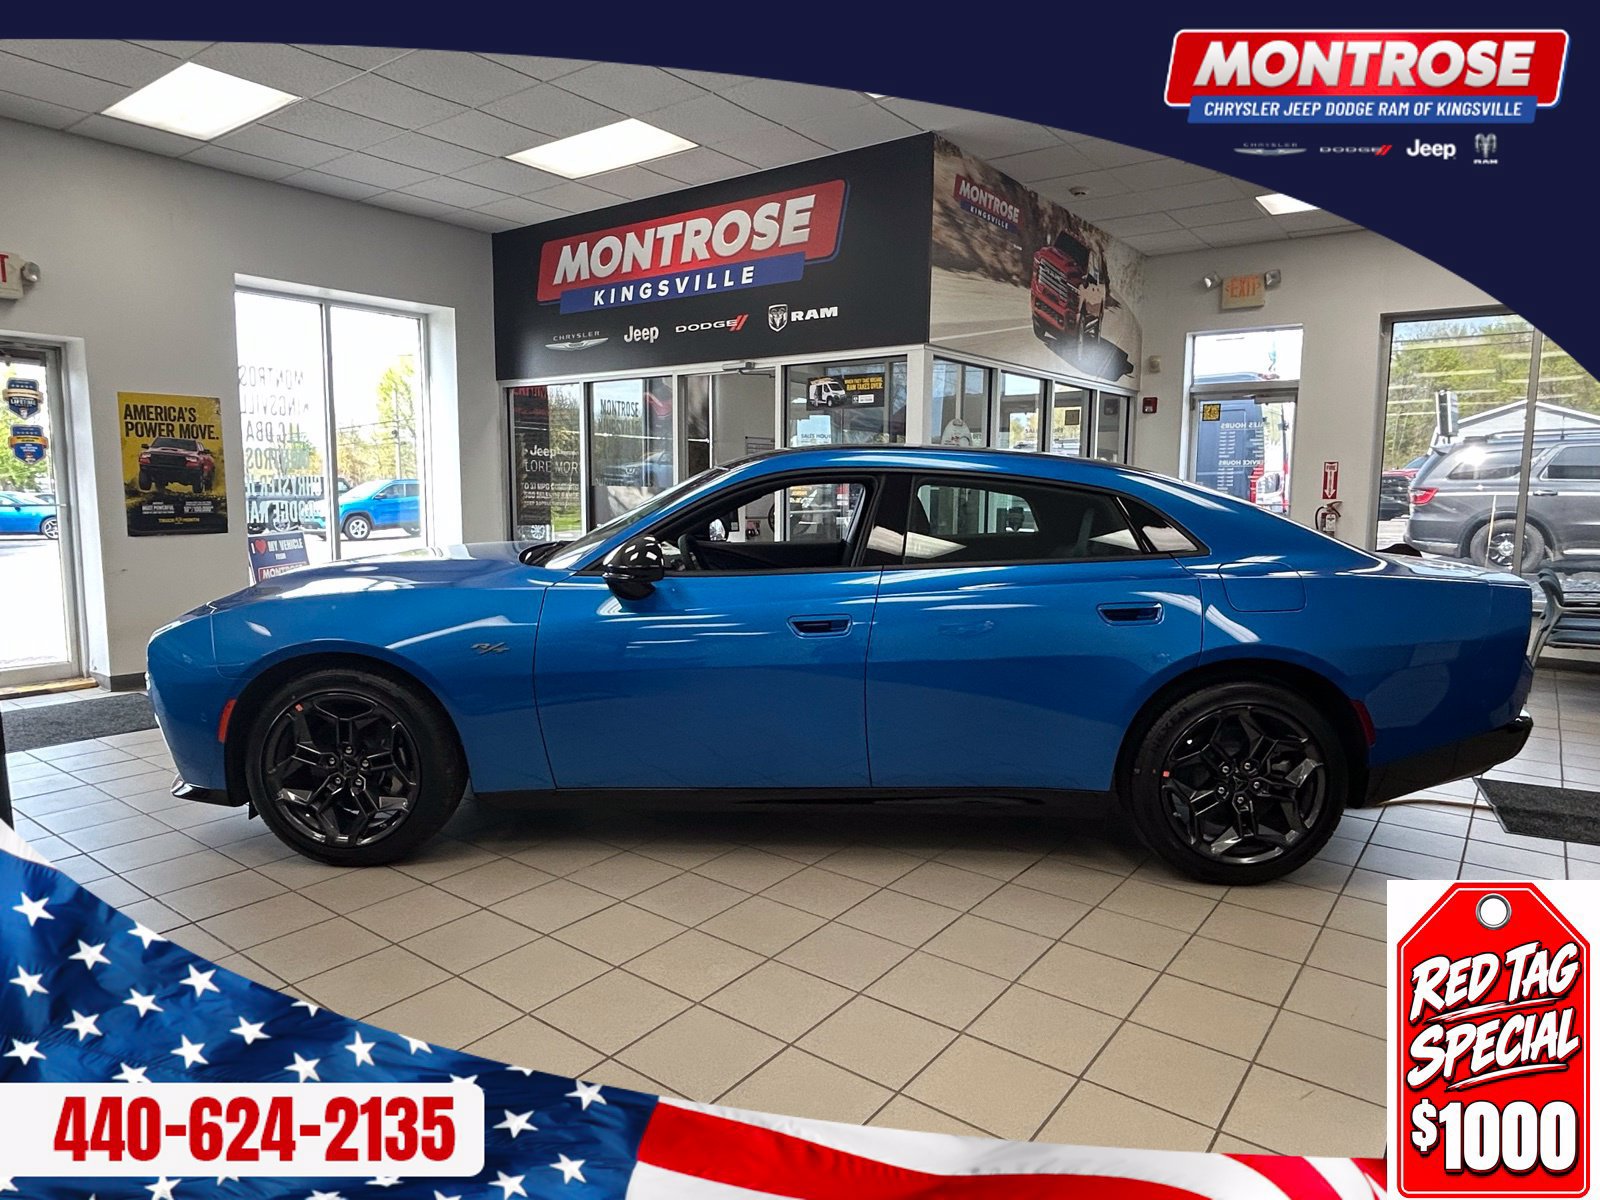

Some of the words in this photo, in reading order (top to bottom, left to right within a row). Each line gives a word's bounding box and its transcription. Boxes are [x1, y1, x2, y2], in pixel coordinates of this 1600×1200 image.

[959, 179, 1020, 224] MONTROSE
[970, 205, 1009, 230] KINGSVILLE
[552, 194, 817, 286] MONTROSE
[593, 265, 755, 306] KINGSVILLE
[1230, 274, 1257, 297] EXIT
[791, 306, 838, 321] RAM
[623, 325, 660, 343] Jeep
[675, 319, 738, 333] DODGE
[553, 331, 600, 341] CHRYSLER
[124, 404, 196, 422] AMERICA'S
[600, 399, 639, 417] MONTROSE
[125, 421, 175, 438] POWER
[179, 423, 219, 440] MOVE.
[529, 444, 557, 459] Jeep
[250, 542, 256, 554] I
[280, 538, 304, 551] VEHICLE
